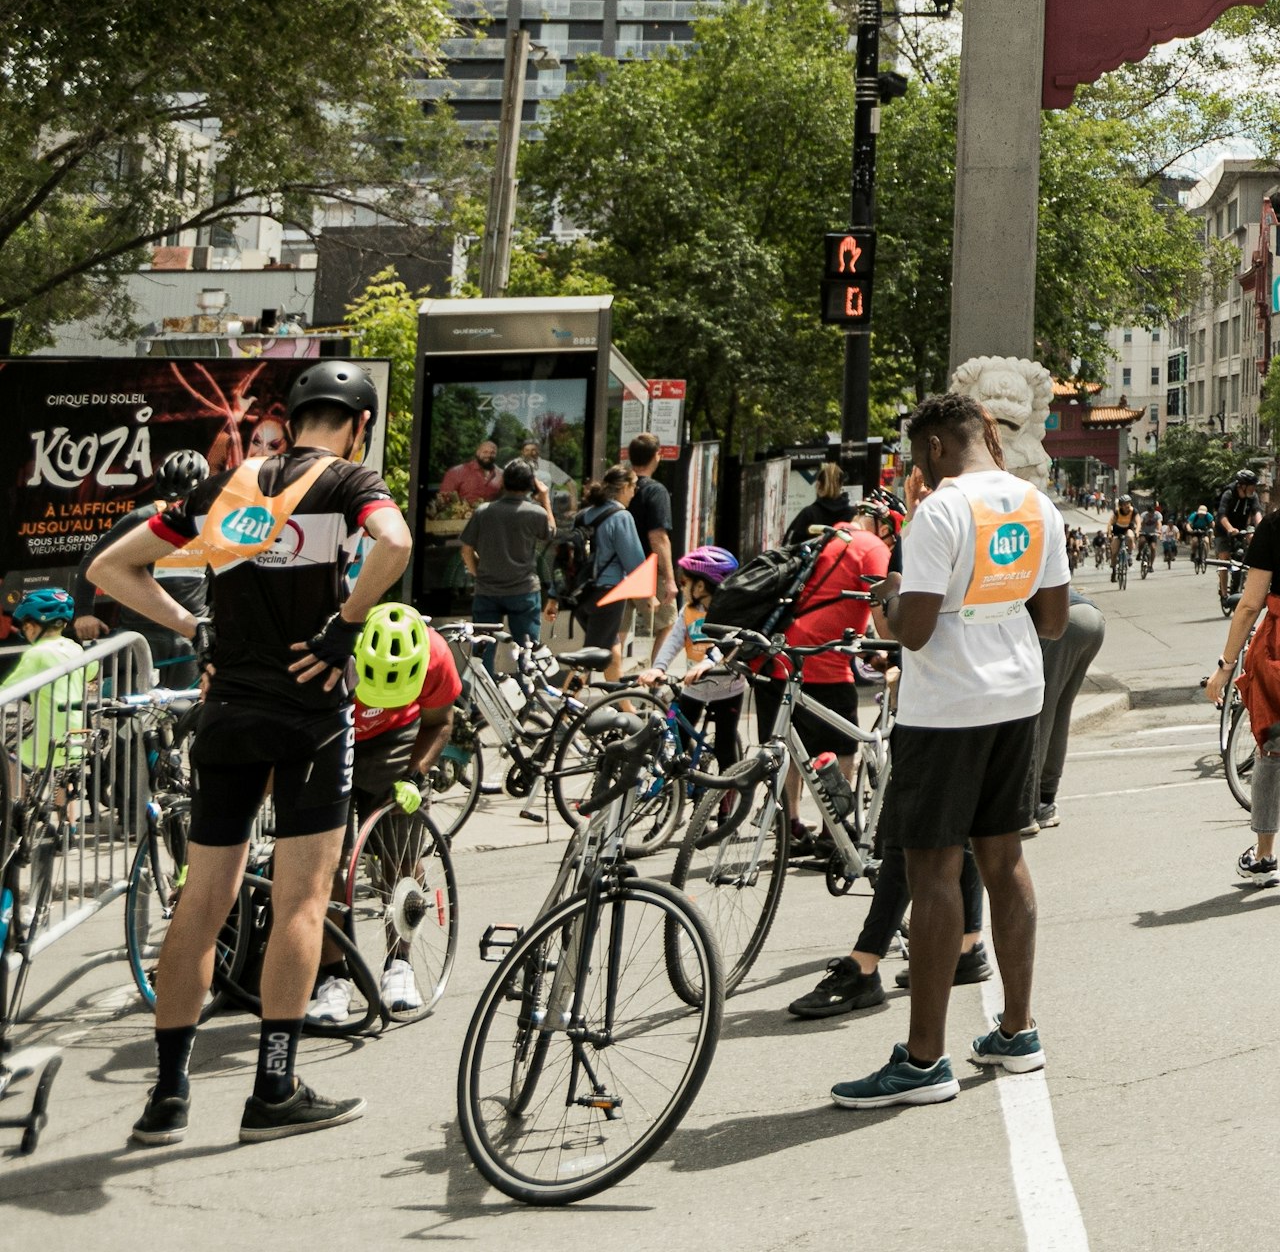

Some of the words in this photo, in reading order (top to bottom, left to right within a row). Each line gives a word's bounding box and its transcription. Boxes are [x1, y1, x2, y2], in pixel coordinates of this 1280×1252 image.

[573, 337, 597, 345] 8882
[47, 395, 89, 408] CIRQUE
[92, 395, 108, 404] DU
[110, 393, 147, 404] SOLEIL
[477, 392, 545, 411] zeste
[45, 502, 56, 518] À
[61, 500, 136, 516] L'AFFICHE
[18, 519, 94, 536] JUSQU'AU
[98, 518, 113, 529] 14
[229, 507, 272, 539] lait
[28, 537, 52, 547] SOUS
[54, 536, 65, 545] LE
[67, 534, 98, 544] GRAND
[993, 529, 1029, 555] lait
[30, 544, 82, 554] VIEUX-PORT
[257, 554, 287, 565] cycling
